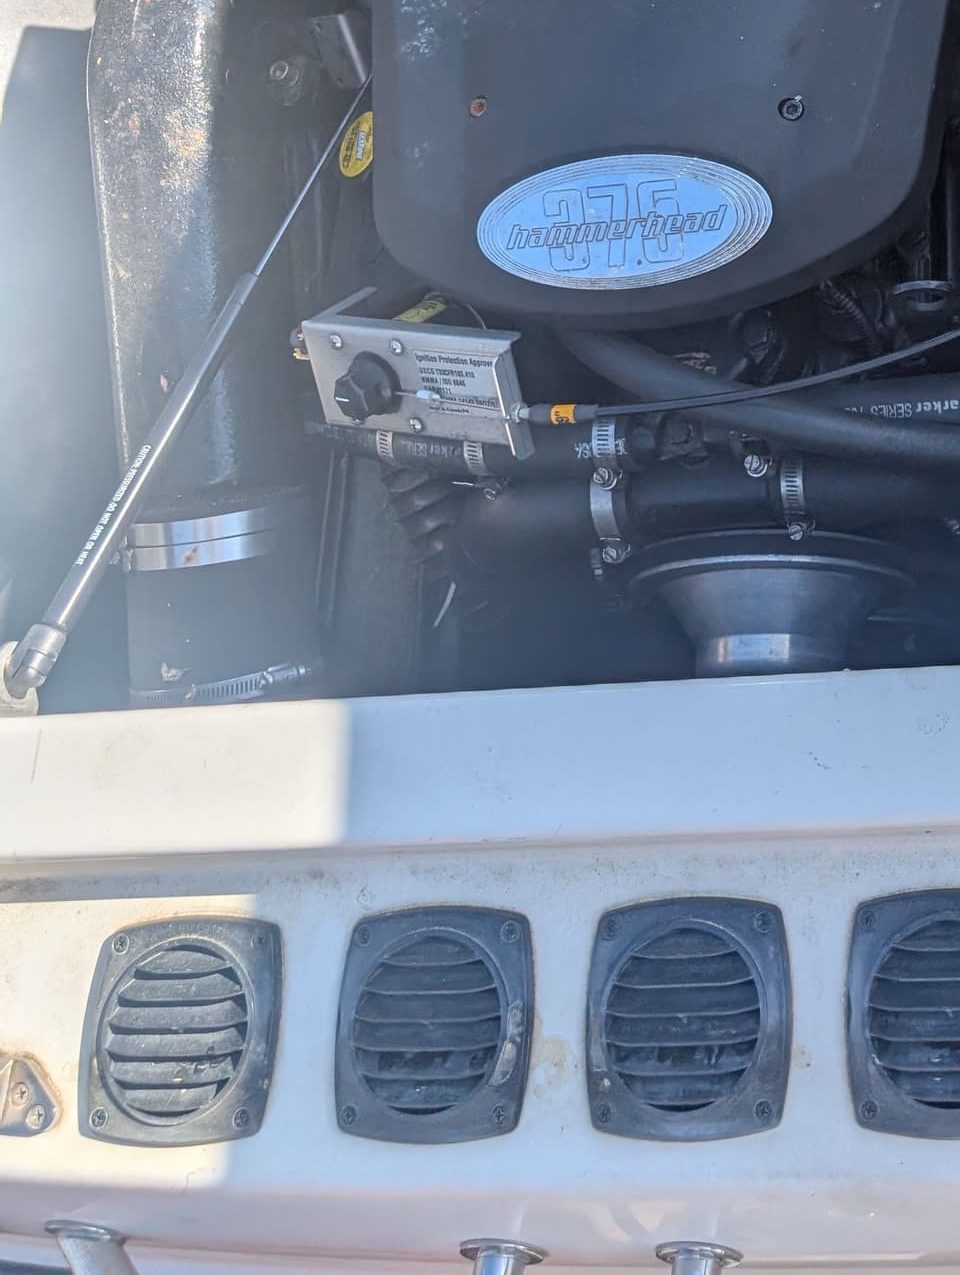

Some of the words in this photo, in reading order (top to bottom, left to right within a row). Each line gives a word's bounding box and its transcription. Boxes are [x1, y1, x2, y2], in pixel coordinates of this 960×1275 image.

[505, 203, 729, 251] hammerhead
[542, 179, 686, 273] 376
[414, 352, 438, 363] Ignition
[438, 355, 469, 366] Protection
